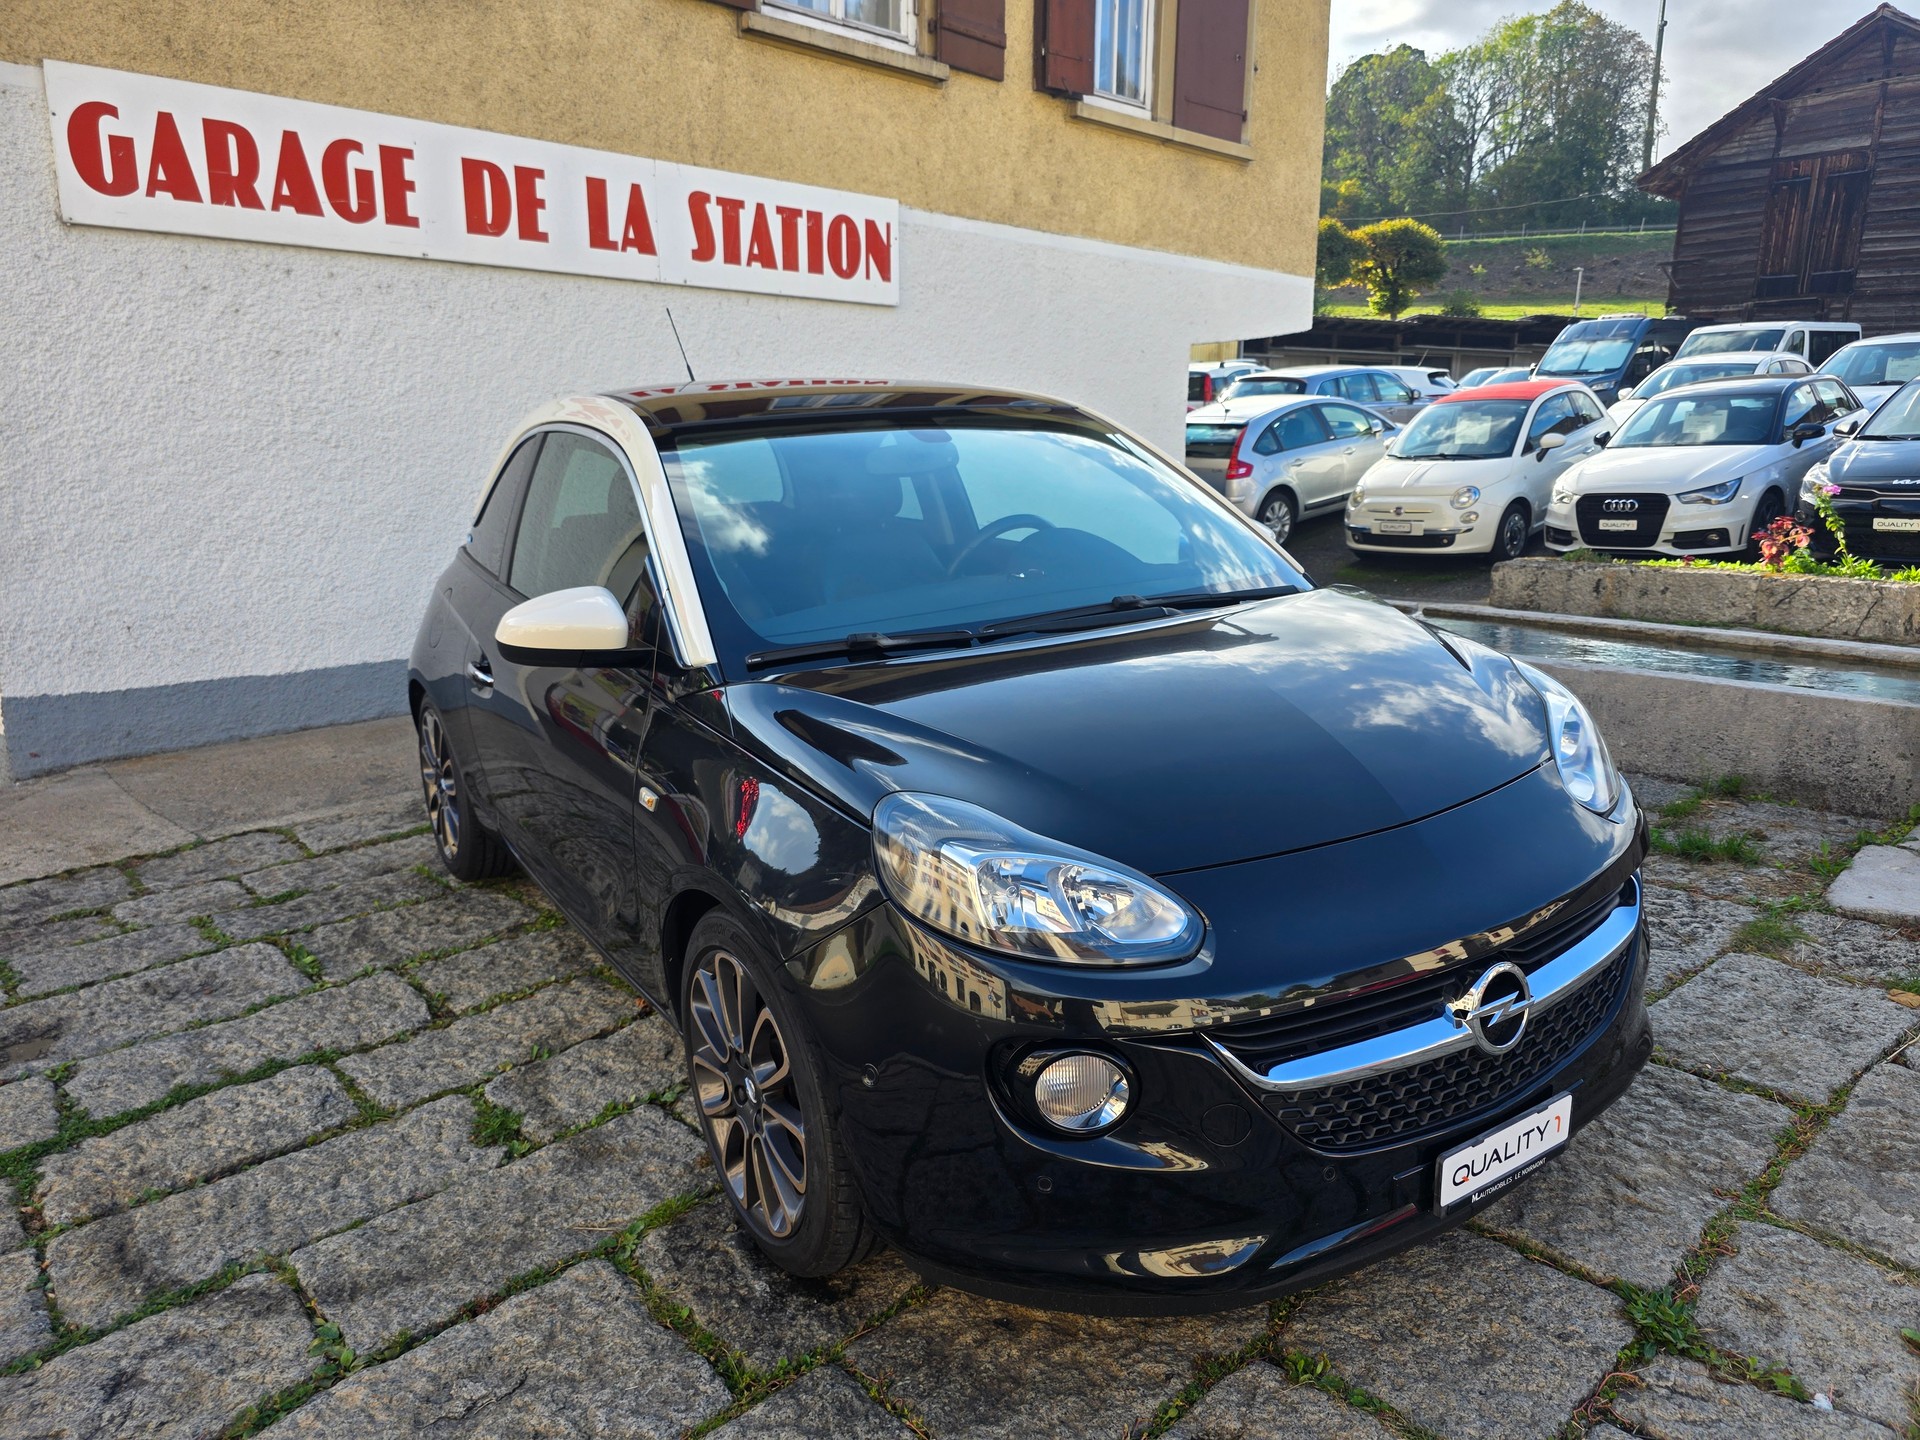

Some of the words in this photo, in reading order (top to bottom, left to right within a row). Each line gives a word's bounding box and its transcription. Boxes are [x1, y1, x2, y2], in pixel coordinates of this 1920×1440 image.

[67, 102, 420, 229] GARAGE
[461, 157, 549, 243] DE
[585, 176, 658, 256] LA
[688, 190, 892, 283] STATION
[1453, 1120, 1550, 1187] QUALITY
[1554, 1115, 1562, 1133] 1
[1514, 1172, 1522, 1180] LE
[1522, 1157, 1547, 1176] NOIRMONT
